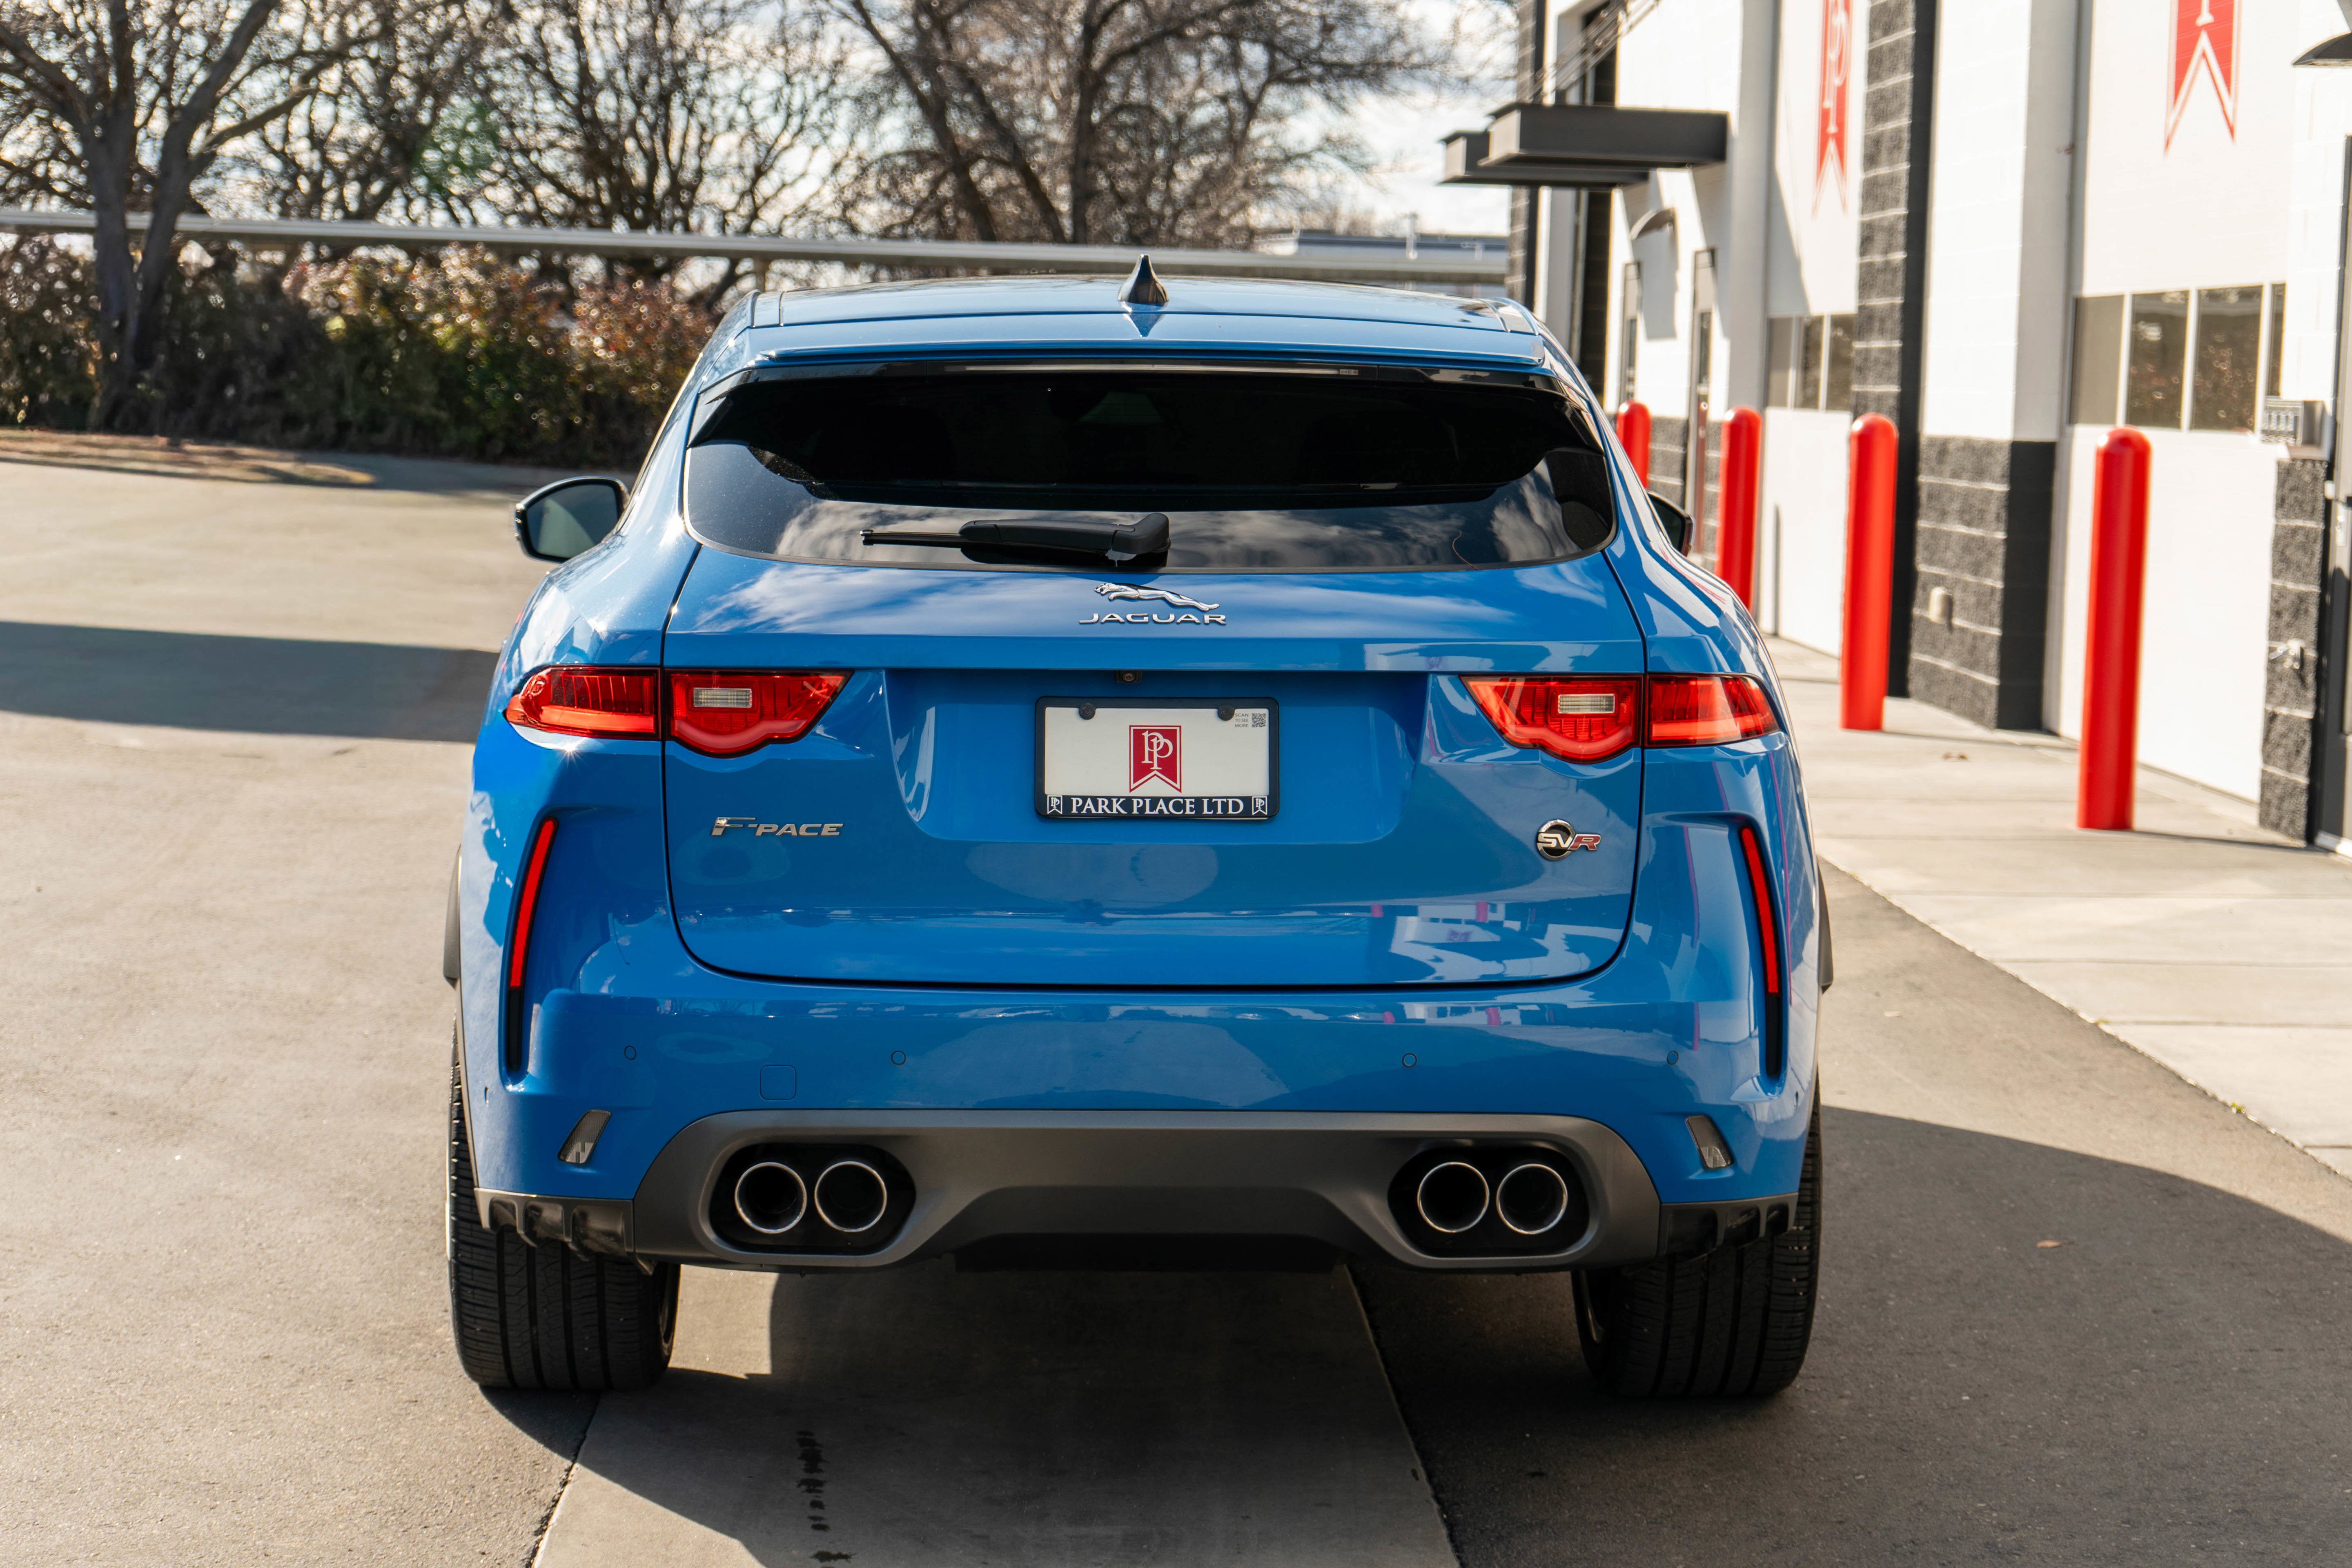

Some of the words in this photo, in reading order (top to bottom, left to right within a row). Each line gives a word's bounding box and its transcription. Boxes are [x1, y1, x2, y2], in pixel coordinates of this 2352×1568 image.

[1079, 613, 1227, 625] JAGUAR
[1070, 797, 1128, 814] PARK
[1131, 798, 1196, 815] PLACE
[1202, 798, 1244, 814] LTD
[1537, 832, 1601, 851] SVR
